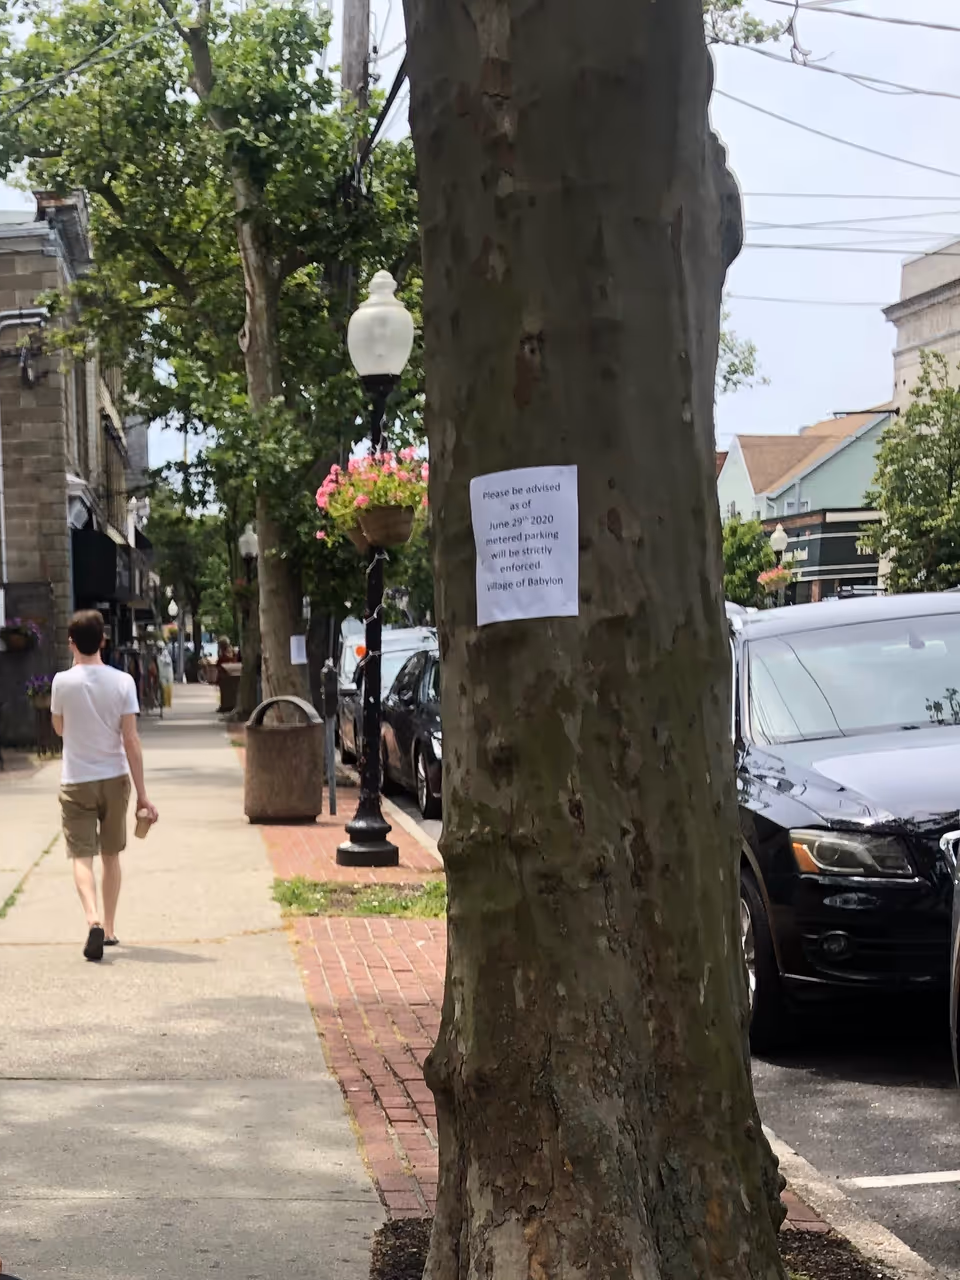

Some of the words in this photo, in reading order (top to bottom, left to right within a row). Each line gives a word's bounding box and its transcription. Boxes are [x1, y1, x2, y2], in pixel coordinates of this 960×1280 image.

[482, 489, 510, 500] Please
[512, 486, 523, 495] be
[525, 482, 561, 495] advised
[509, 502, 520, 511] as
[521, 499, 532, 509] of
[489, 521, 510, 531] June
[530, 514, 554, 525] 2020
[485, 532, 522, 546] metered
[524, 530, 559, 542] parking
[490, 549, 506, 560] will
[508, 549, 520, 558] be
[521, 545, 553, 556] strictly
[515, 577, 525, 588] of
[527, 576, 564, 588] Babylon
